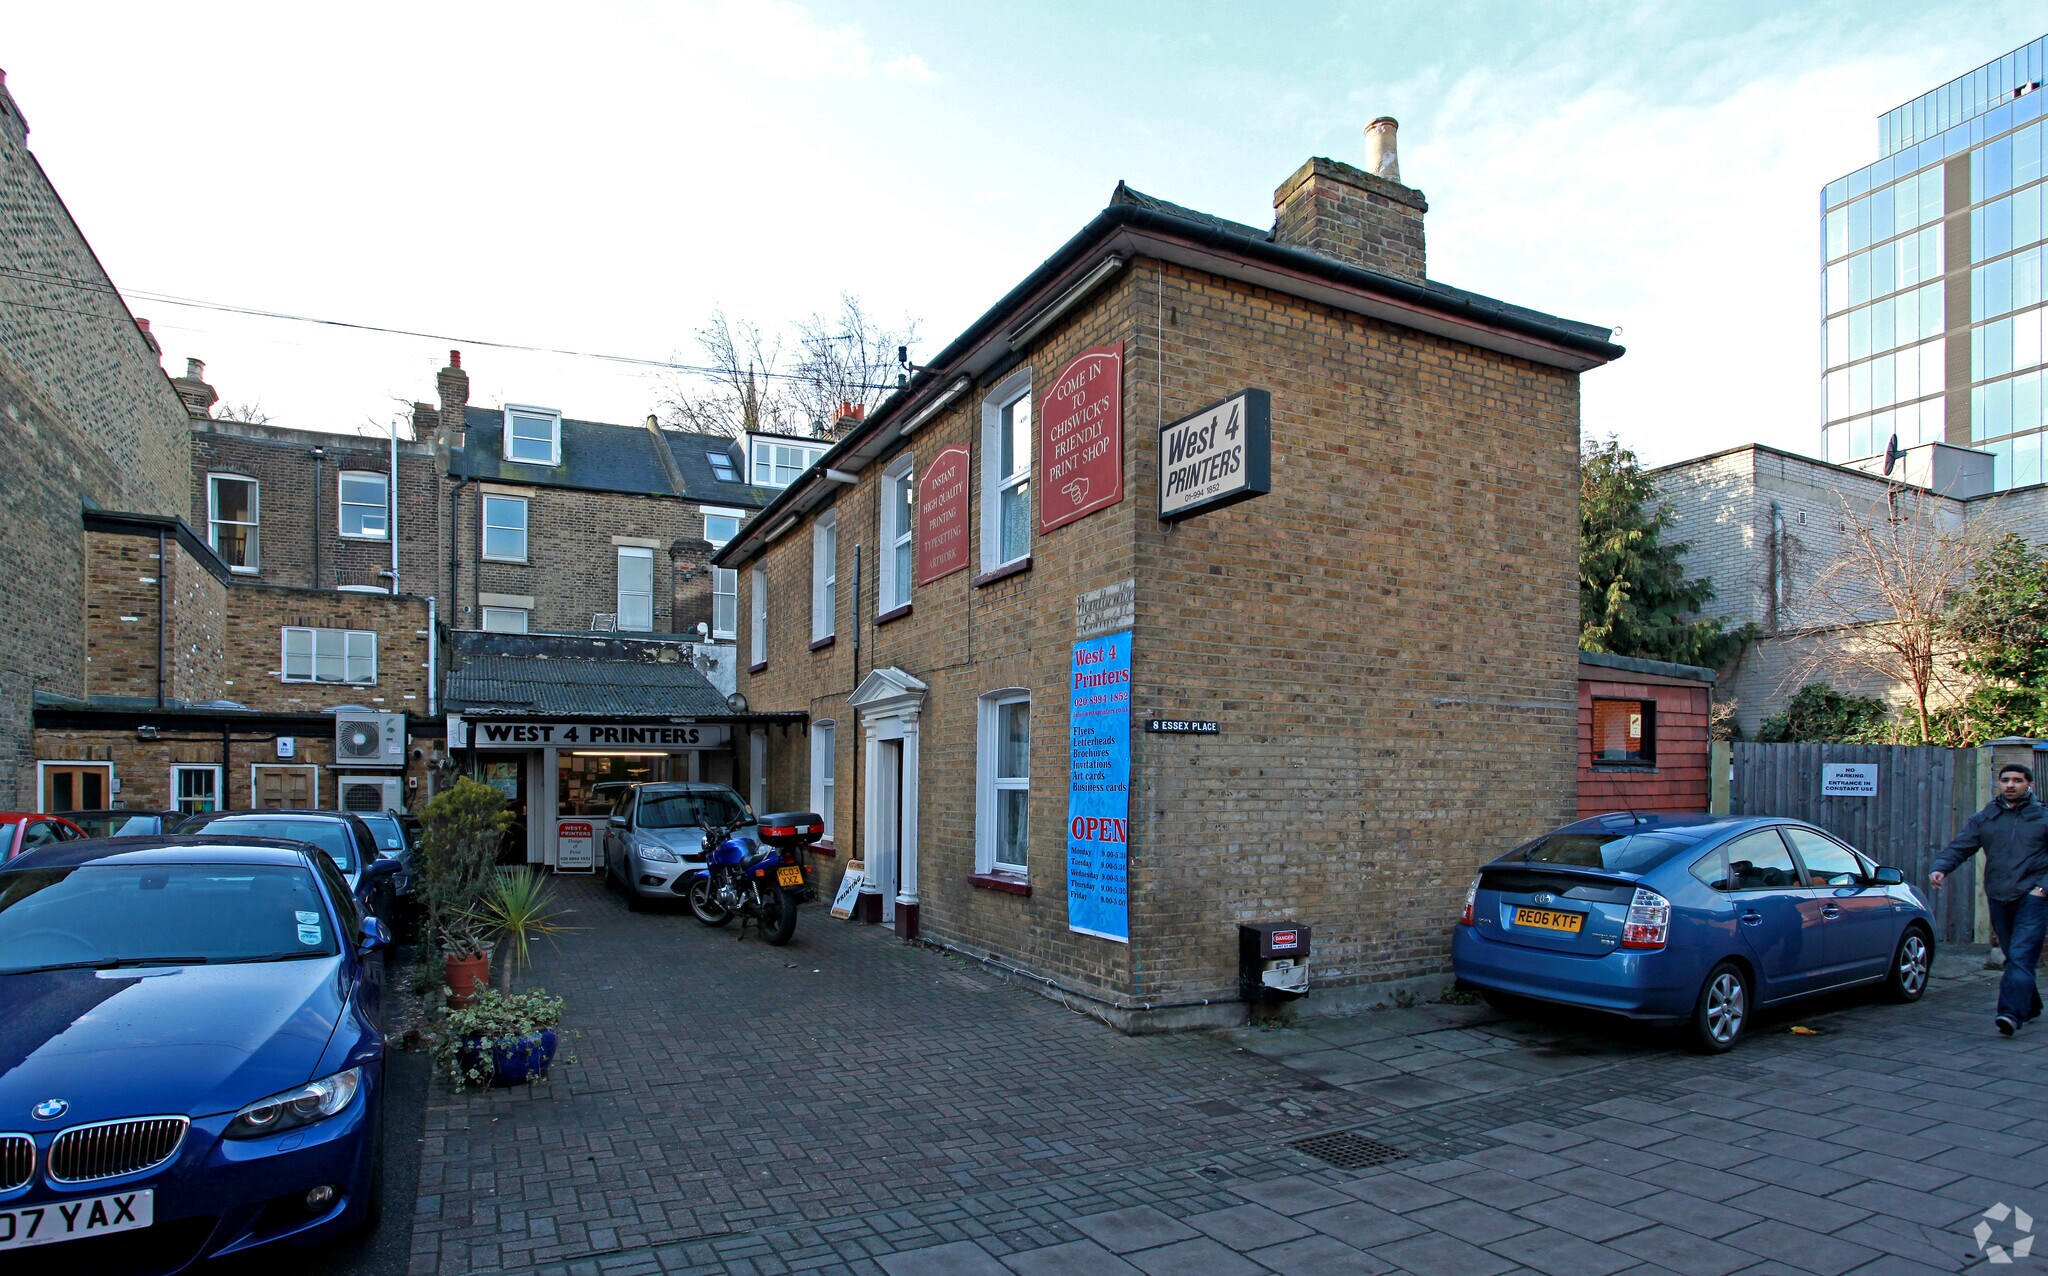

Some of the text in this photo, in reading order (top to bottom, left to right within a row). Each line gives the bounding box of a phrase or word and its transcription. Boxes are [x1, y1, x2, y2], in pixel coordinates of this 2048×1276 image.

[1057, 360, 1102, 401] COME IN
[1072, 390, 1086, 410] TO
[1050, 395, 1110, 442] CHISWICK'S
[1054, 419, 1104, 459] FRIENDLY
[1168, 403, 1240, 466] West 4
[1049, 436, 1110, 483] PRINT SHOP
[932, 466, 956, 490] INSTANT
[1166, 444, 1242, 498] PRINTERS
[923, 481, 963, 514] HIGH QUALITY
[1184, 483, 1220, 502] 01-994 1852
[929, 507, 956, 531] PRINTING
[924, 525, 961, 552] TYPESETTING
[928, 548, 957, 569] ARTWORK
[1075, 644, 1117, 666] West 4
[1074, 668, 1130, 690] Printers
[1074, 691, 1128, 707] 020 8994 1852
[483, 725, 700, 744] WEST 4 PRINTERS
[1073, 726, 1095, 737] Flyers
[1153, 720, 1217, 731] 8 ESSEX PLACE
[1073, 735, 1116, 747] Letterheads
[1073, 748, 1109, 758] Brochures
[1073, 759, 1112, 769] Invitations
[1073, 770, 1105, 780] Art cards
[1073, 782, 1127, 792] Business cards
[1072, 816, 1127, 843] OPEN
[1071, 846, 1091, 857] Monday
[778, 867, 800, 877] KC03
[1071, 858, 1092, 868] Tuesday
[782, 876, 798, 885] XXZ
[1070, 868, 1099, 880] Wednesday
[836, 875, 861, 904] PRINTING
[1070, 879, 1095, 891] Thursday
[1070, 891, 1087, 901] Friday
[1517, 910, 1579, 929] RE06 KTF
[59, 1194, 136, 1233] YAX
